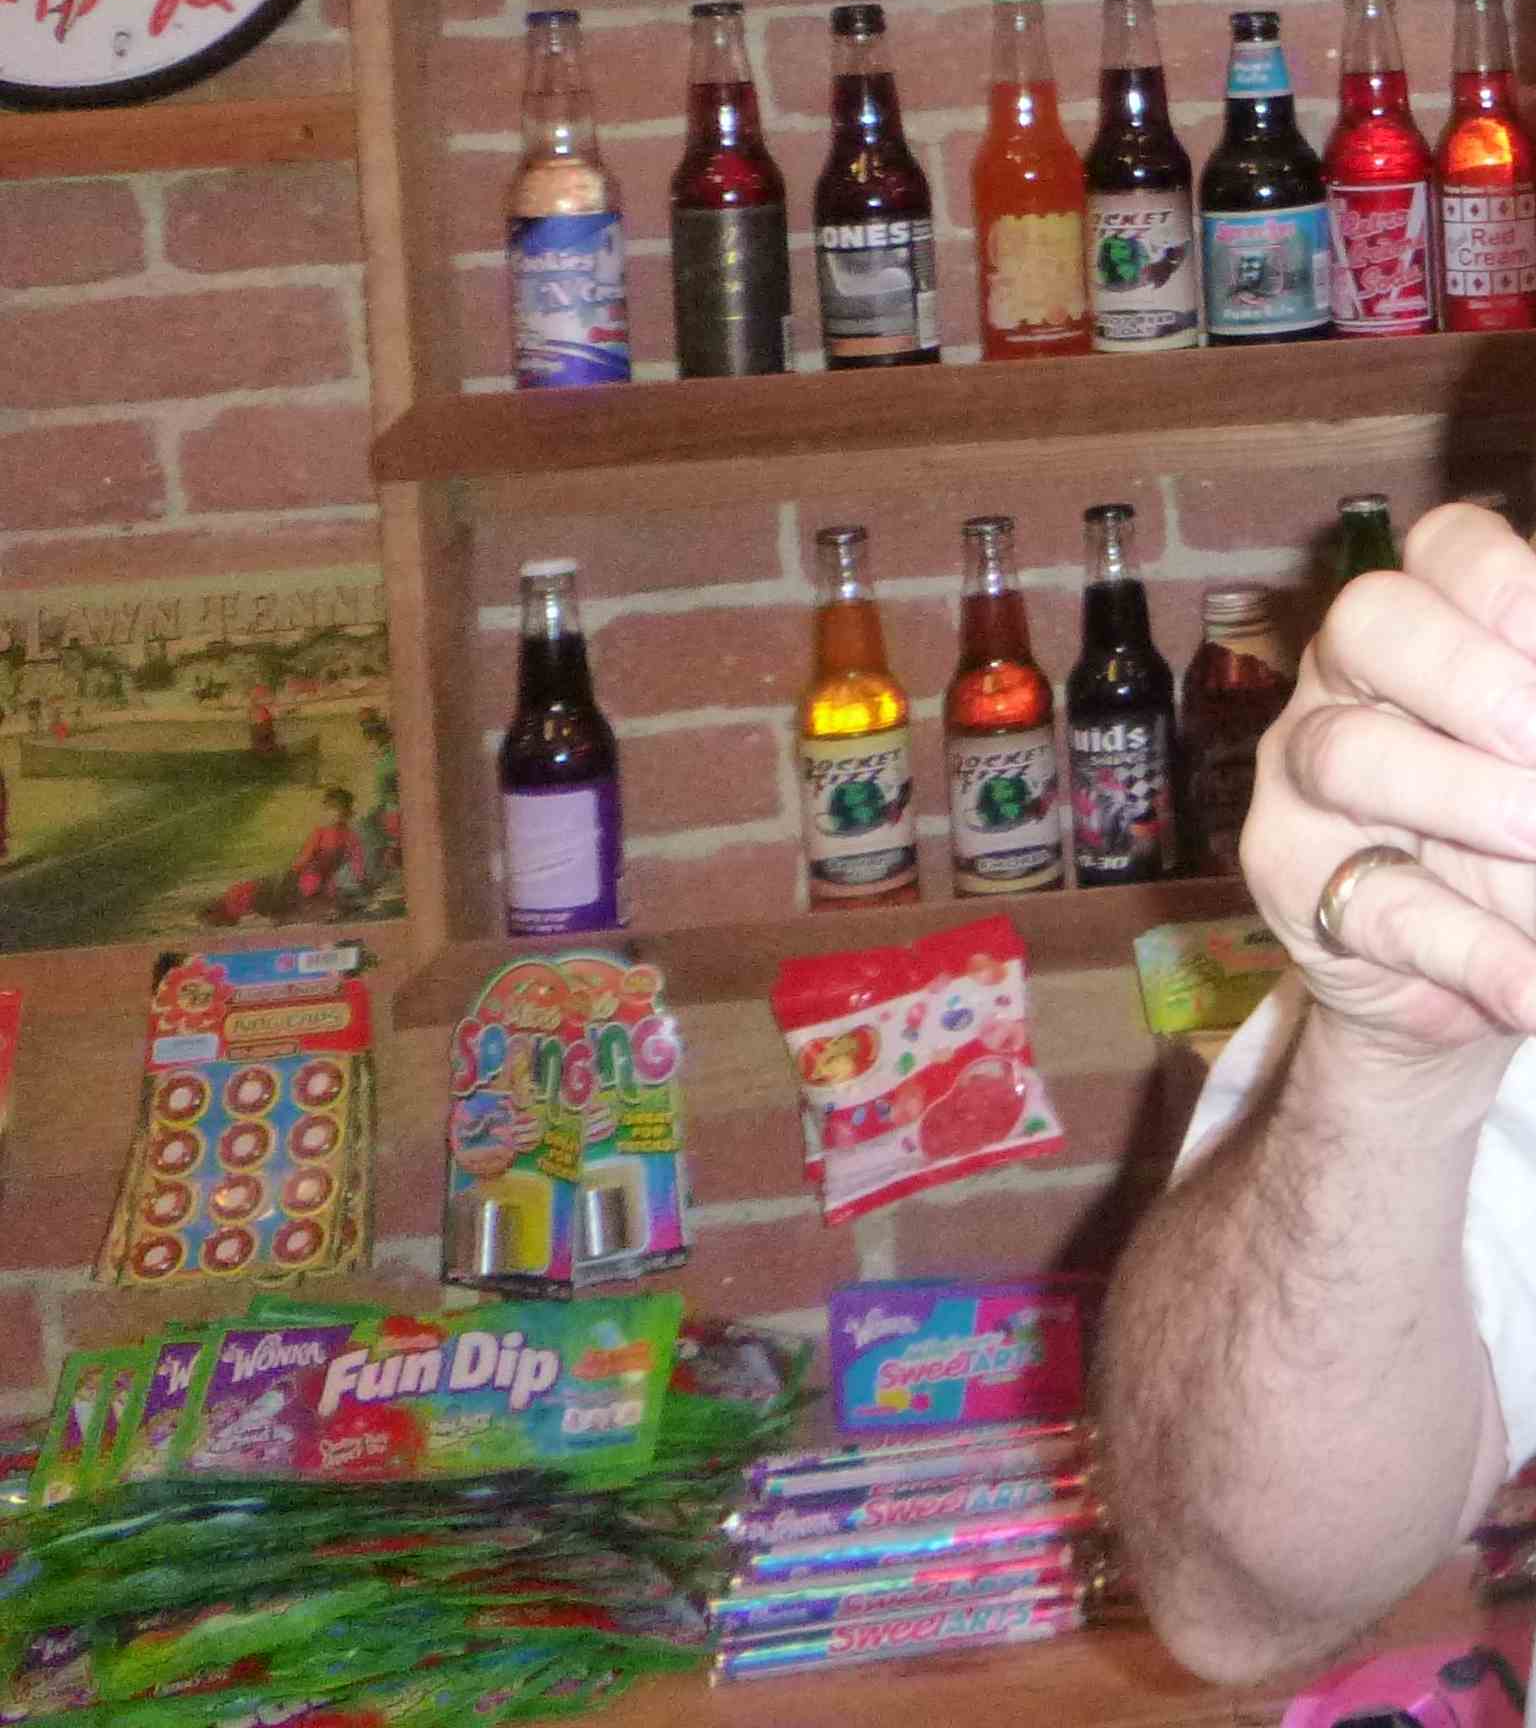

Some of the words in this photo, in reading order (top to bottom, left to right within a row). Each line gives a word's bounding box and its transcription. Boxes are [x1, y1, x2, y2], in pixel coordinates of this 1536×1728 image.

[1471, 225, 1515, 248] Red
[1458, 246, 1529, 267] Cream
[317, 1352, 442, 1418] Fun
[448, 1331, 559, 1412] Dip
